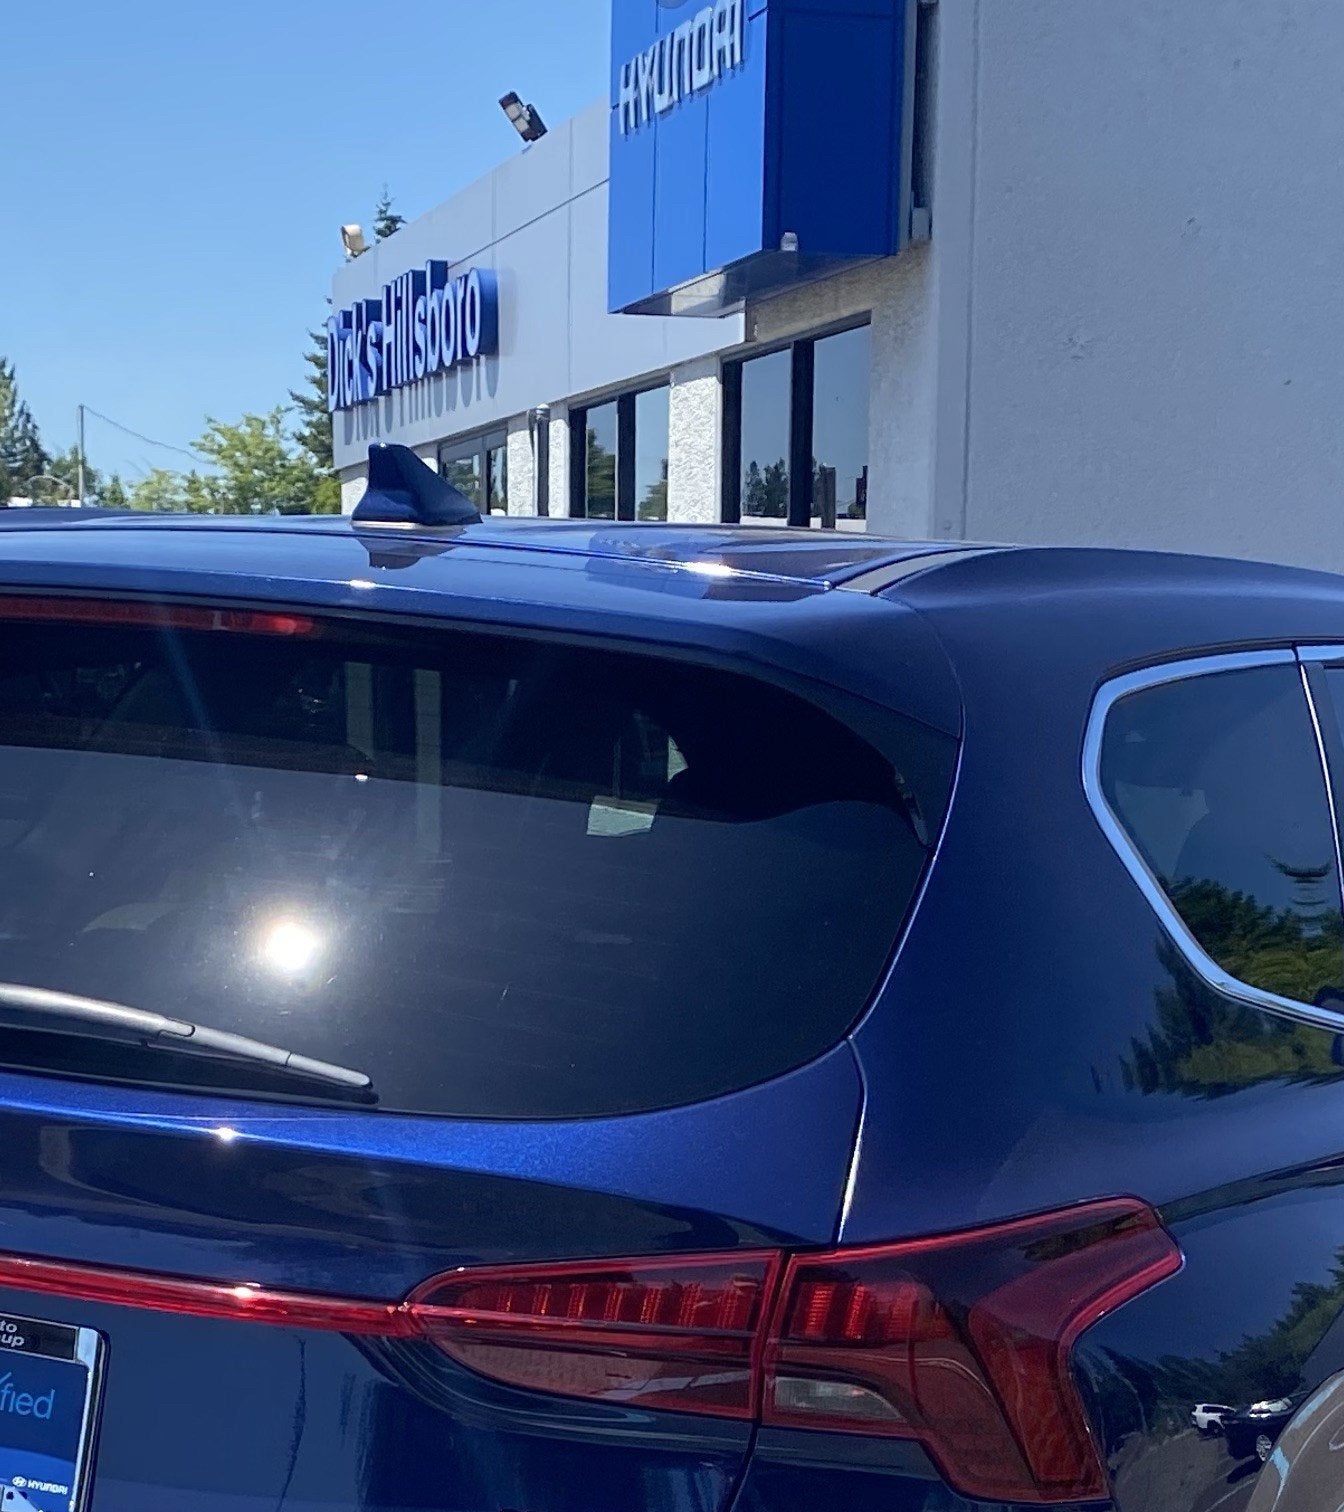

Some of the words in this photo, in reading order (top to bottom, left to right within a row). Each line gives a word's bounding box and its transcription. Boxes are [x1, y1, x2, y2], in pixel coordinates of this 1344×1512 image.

[619, 0, 742, 134] HYUNDAI
[328, 300, 377, 412] Dick's
[382, 259, 481, 391] Hillsboro
